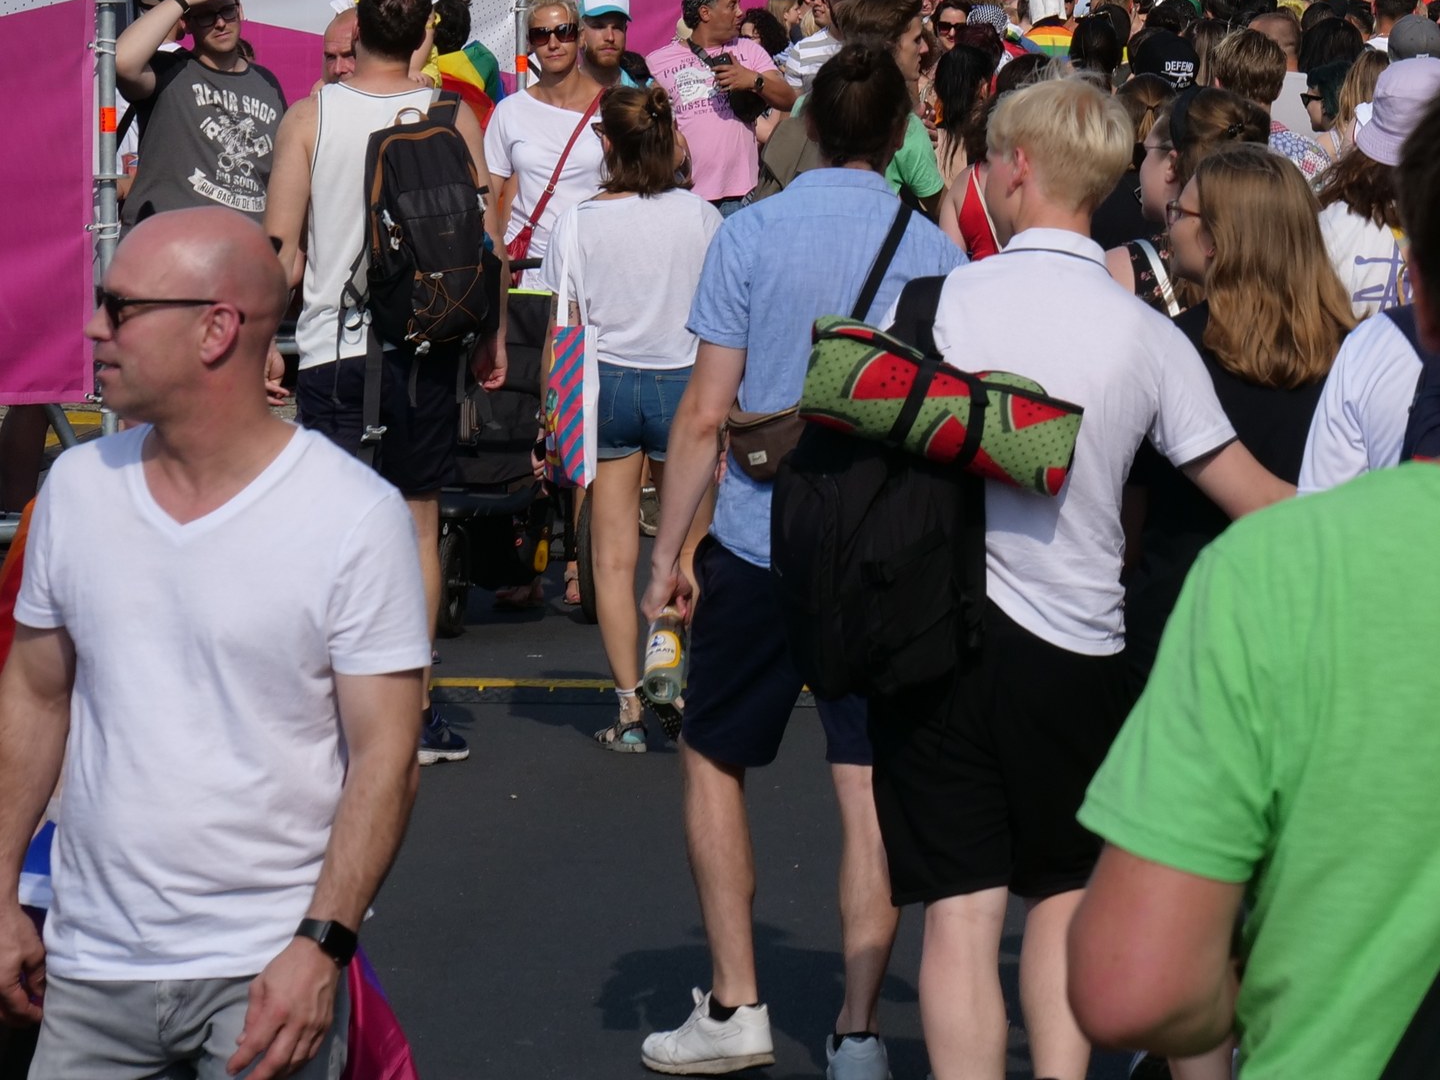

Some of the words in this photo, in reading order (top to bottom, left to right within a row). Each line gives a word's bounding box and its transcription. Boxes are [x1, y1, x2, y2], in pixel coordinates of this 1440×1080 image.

[1165, 61, 1194, 72] DEFEND
[242, 95, 277, 125] SHOP
[200, 181, 215, 197] RUA
[241, 198, 250, 208] DE
